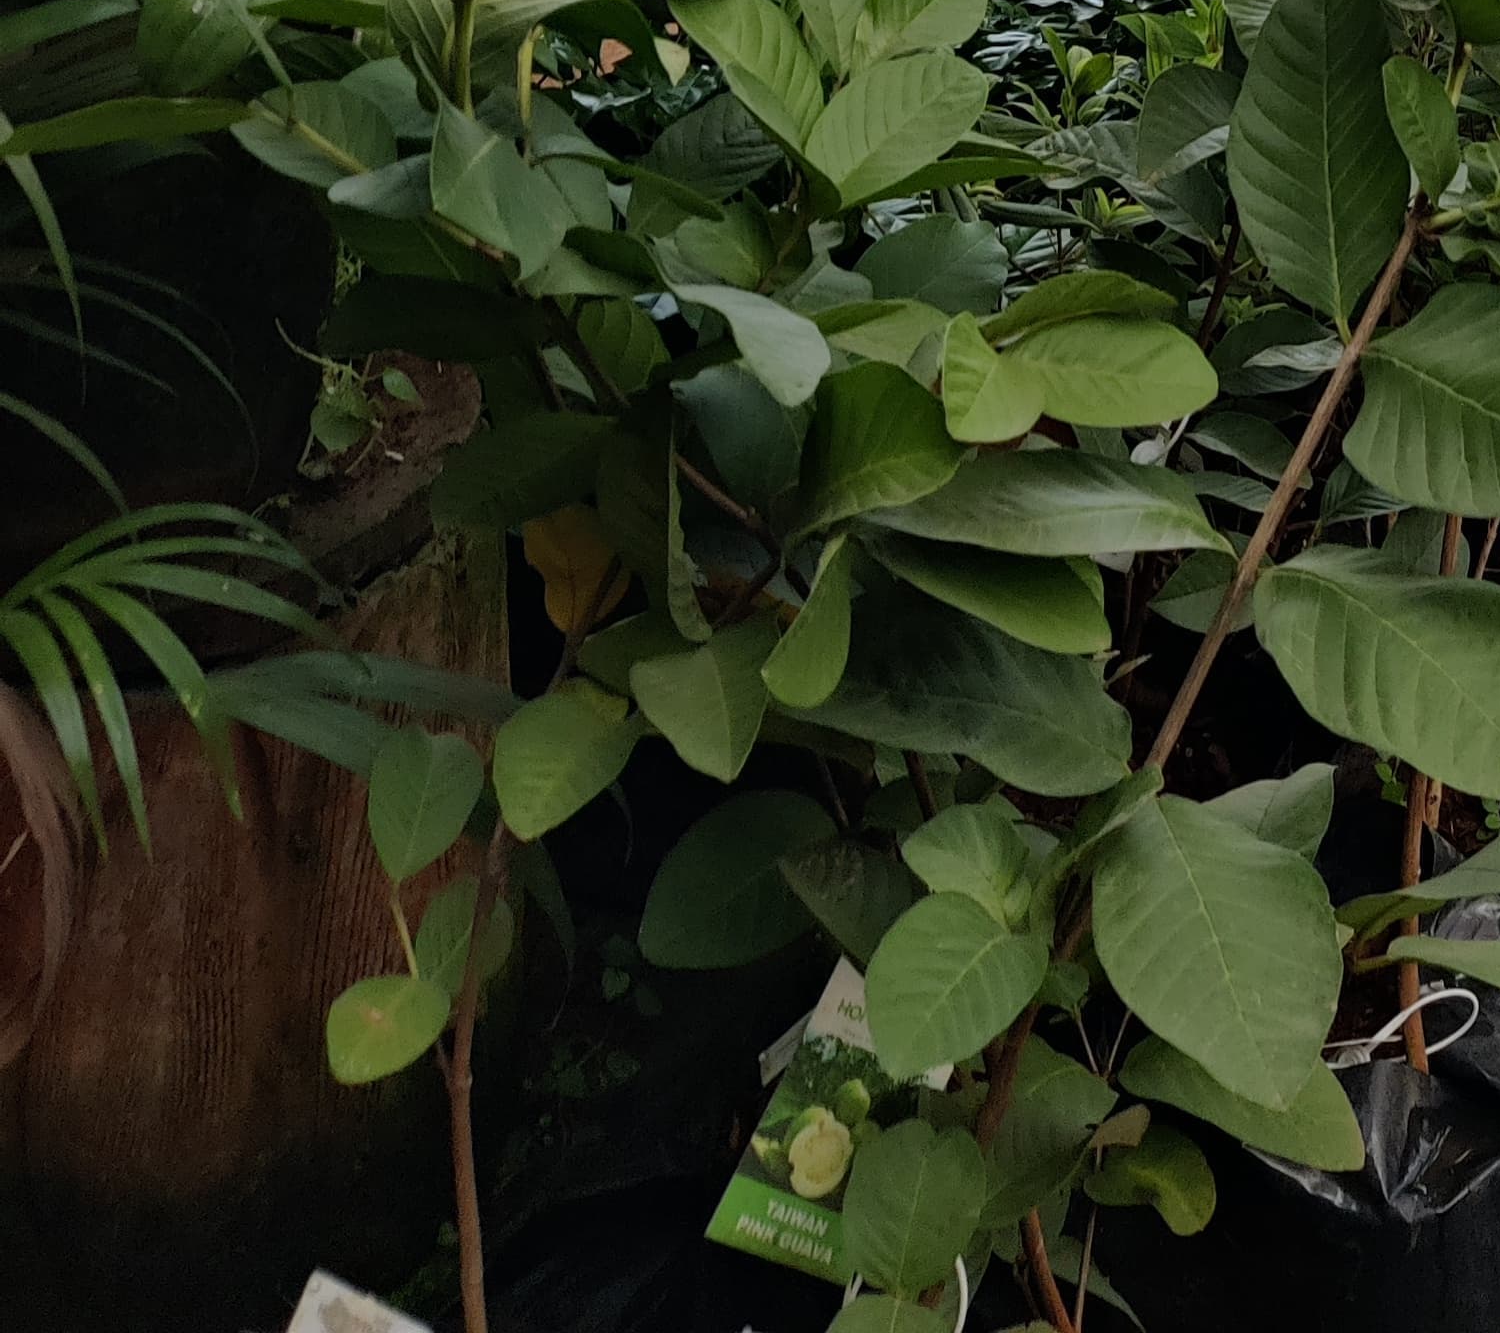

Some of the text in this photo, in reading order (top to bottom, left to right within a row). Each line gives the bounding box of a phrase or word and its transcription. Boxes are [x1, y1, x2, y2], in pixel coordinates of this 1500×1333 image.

[735, 1215, 832, 1265] PINK GUAVA
[767, 1200, 828, 1237] TAIWAN
